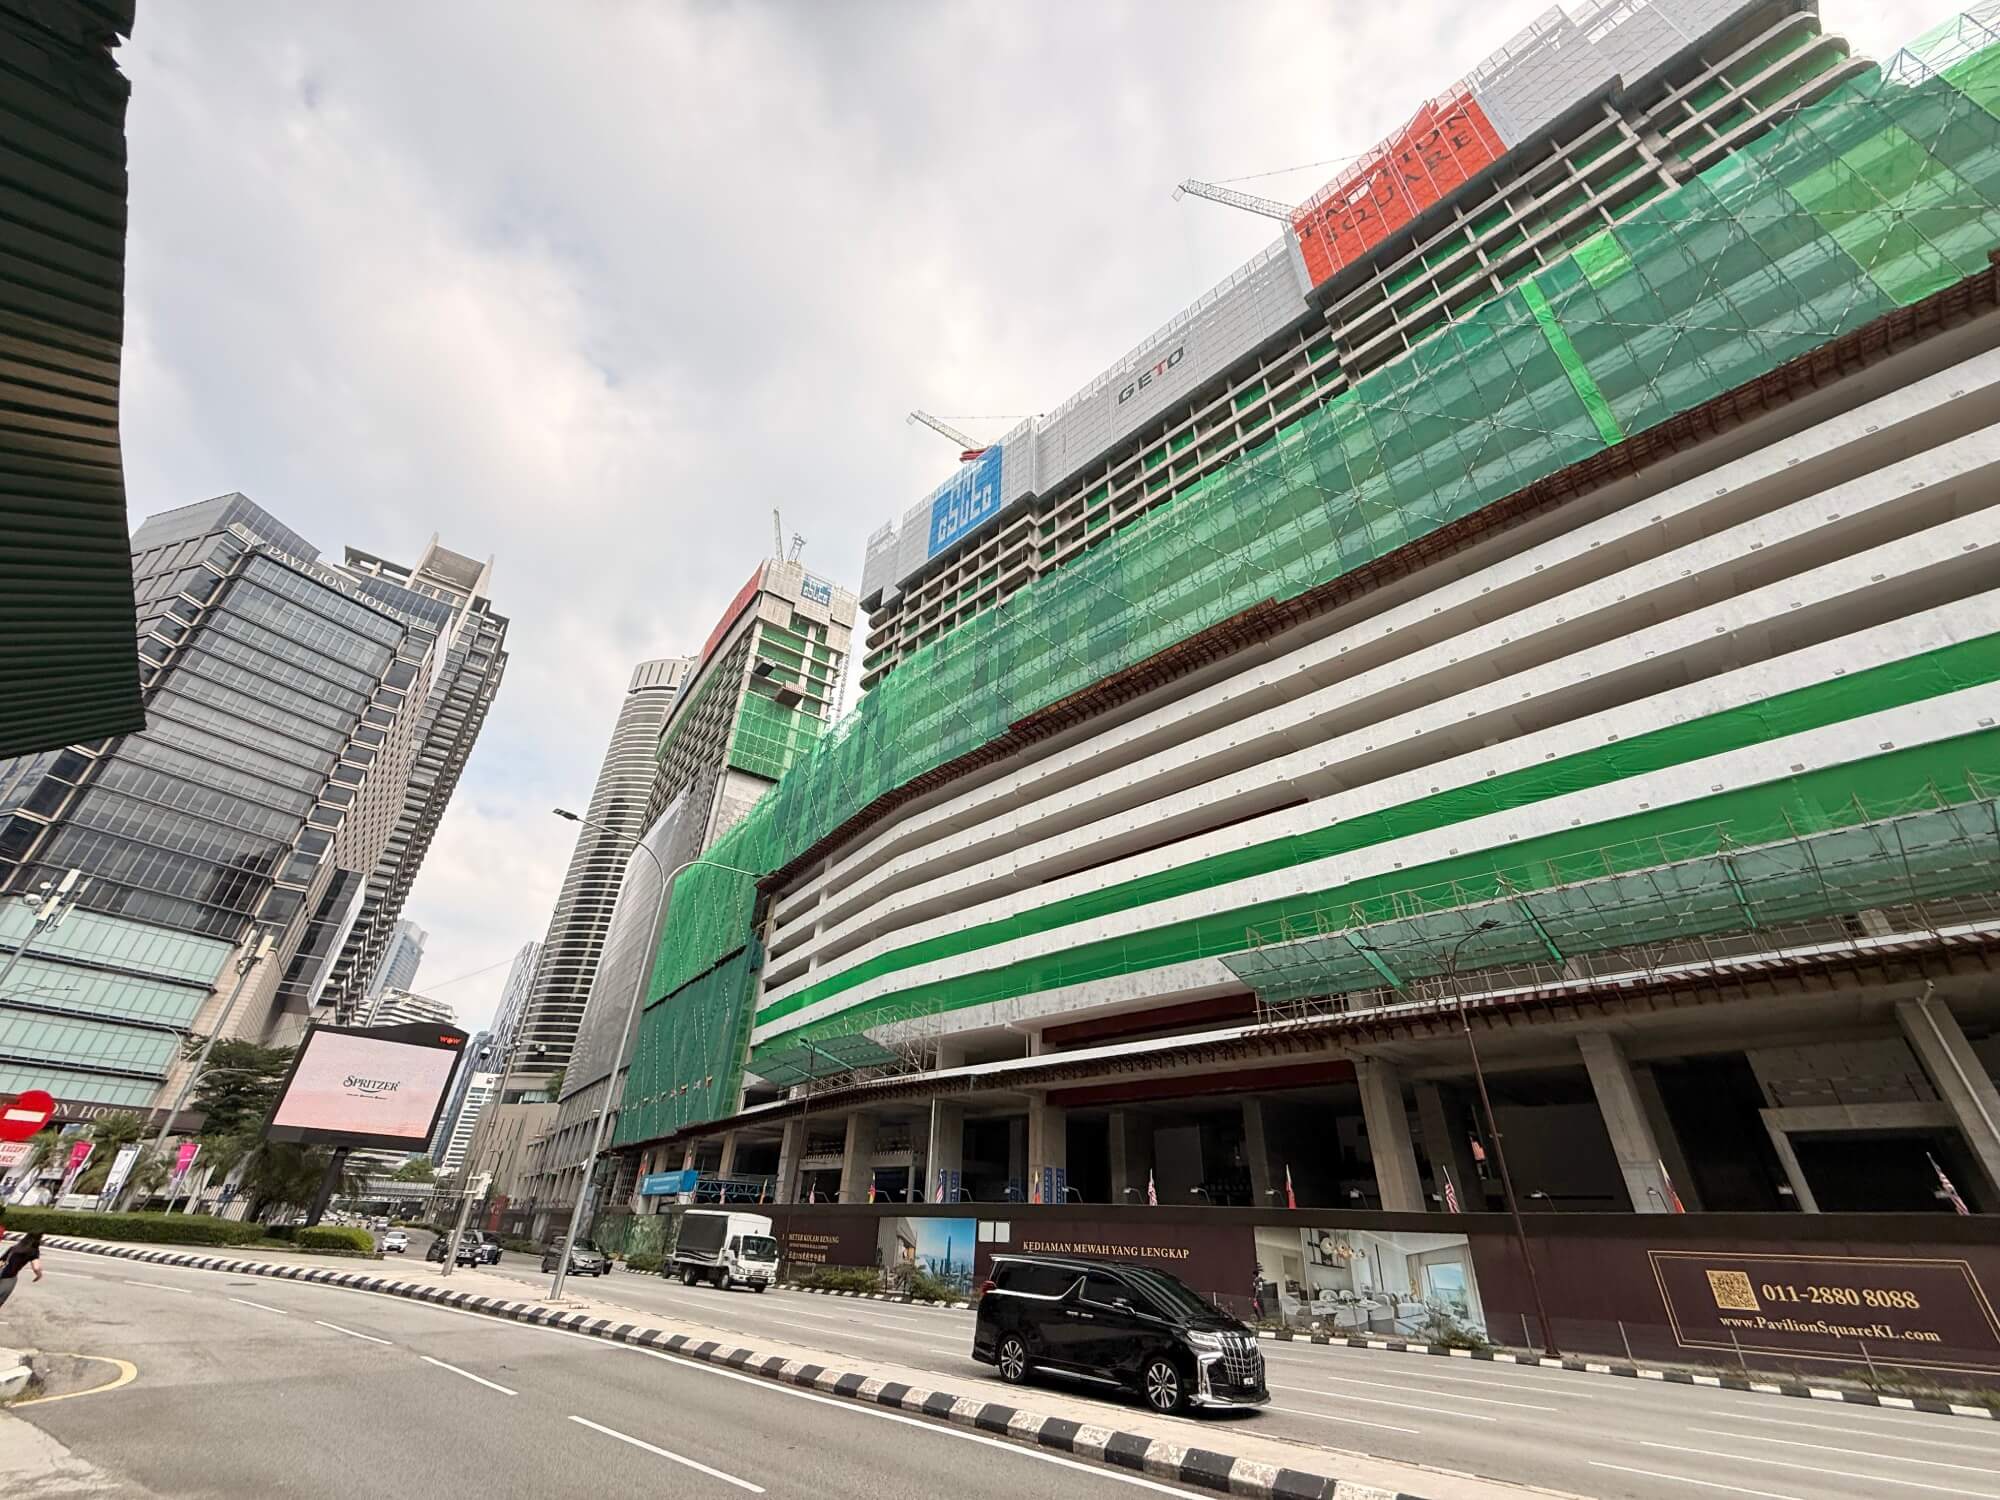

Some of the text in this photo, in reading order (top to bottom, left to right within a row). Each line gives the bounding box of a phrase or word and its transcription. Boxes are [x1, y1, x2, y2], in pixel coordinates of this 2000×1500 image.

[1118, 346, 1184, 405] GETO
[267, 545, 407, 623] PAVILION HOTEL
[343, 1075, 399, 1092] SPRITZER
[1023, 1241, 1190, 1259] KEDIAMAN MEWAH YANG LENGKAP
[1761, 1283, 1921, 1309] 011-2880 8088
[1719, 1315, 1942, 1342] www.PavilionSquareKL.com
